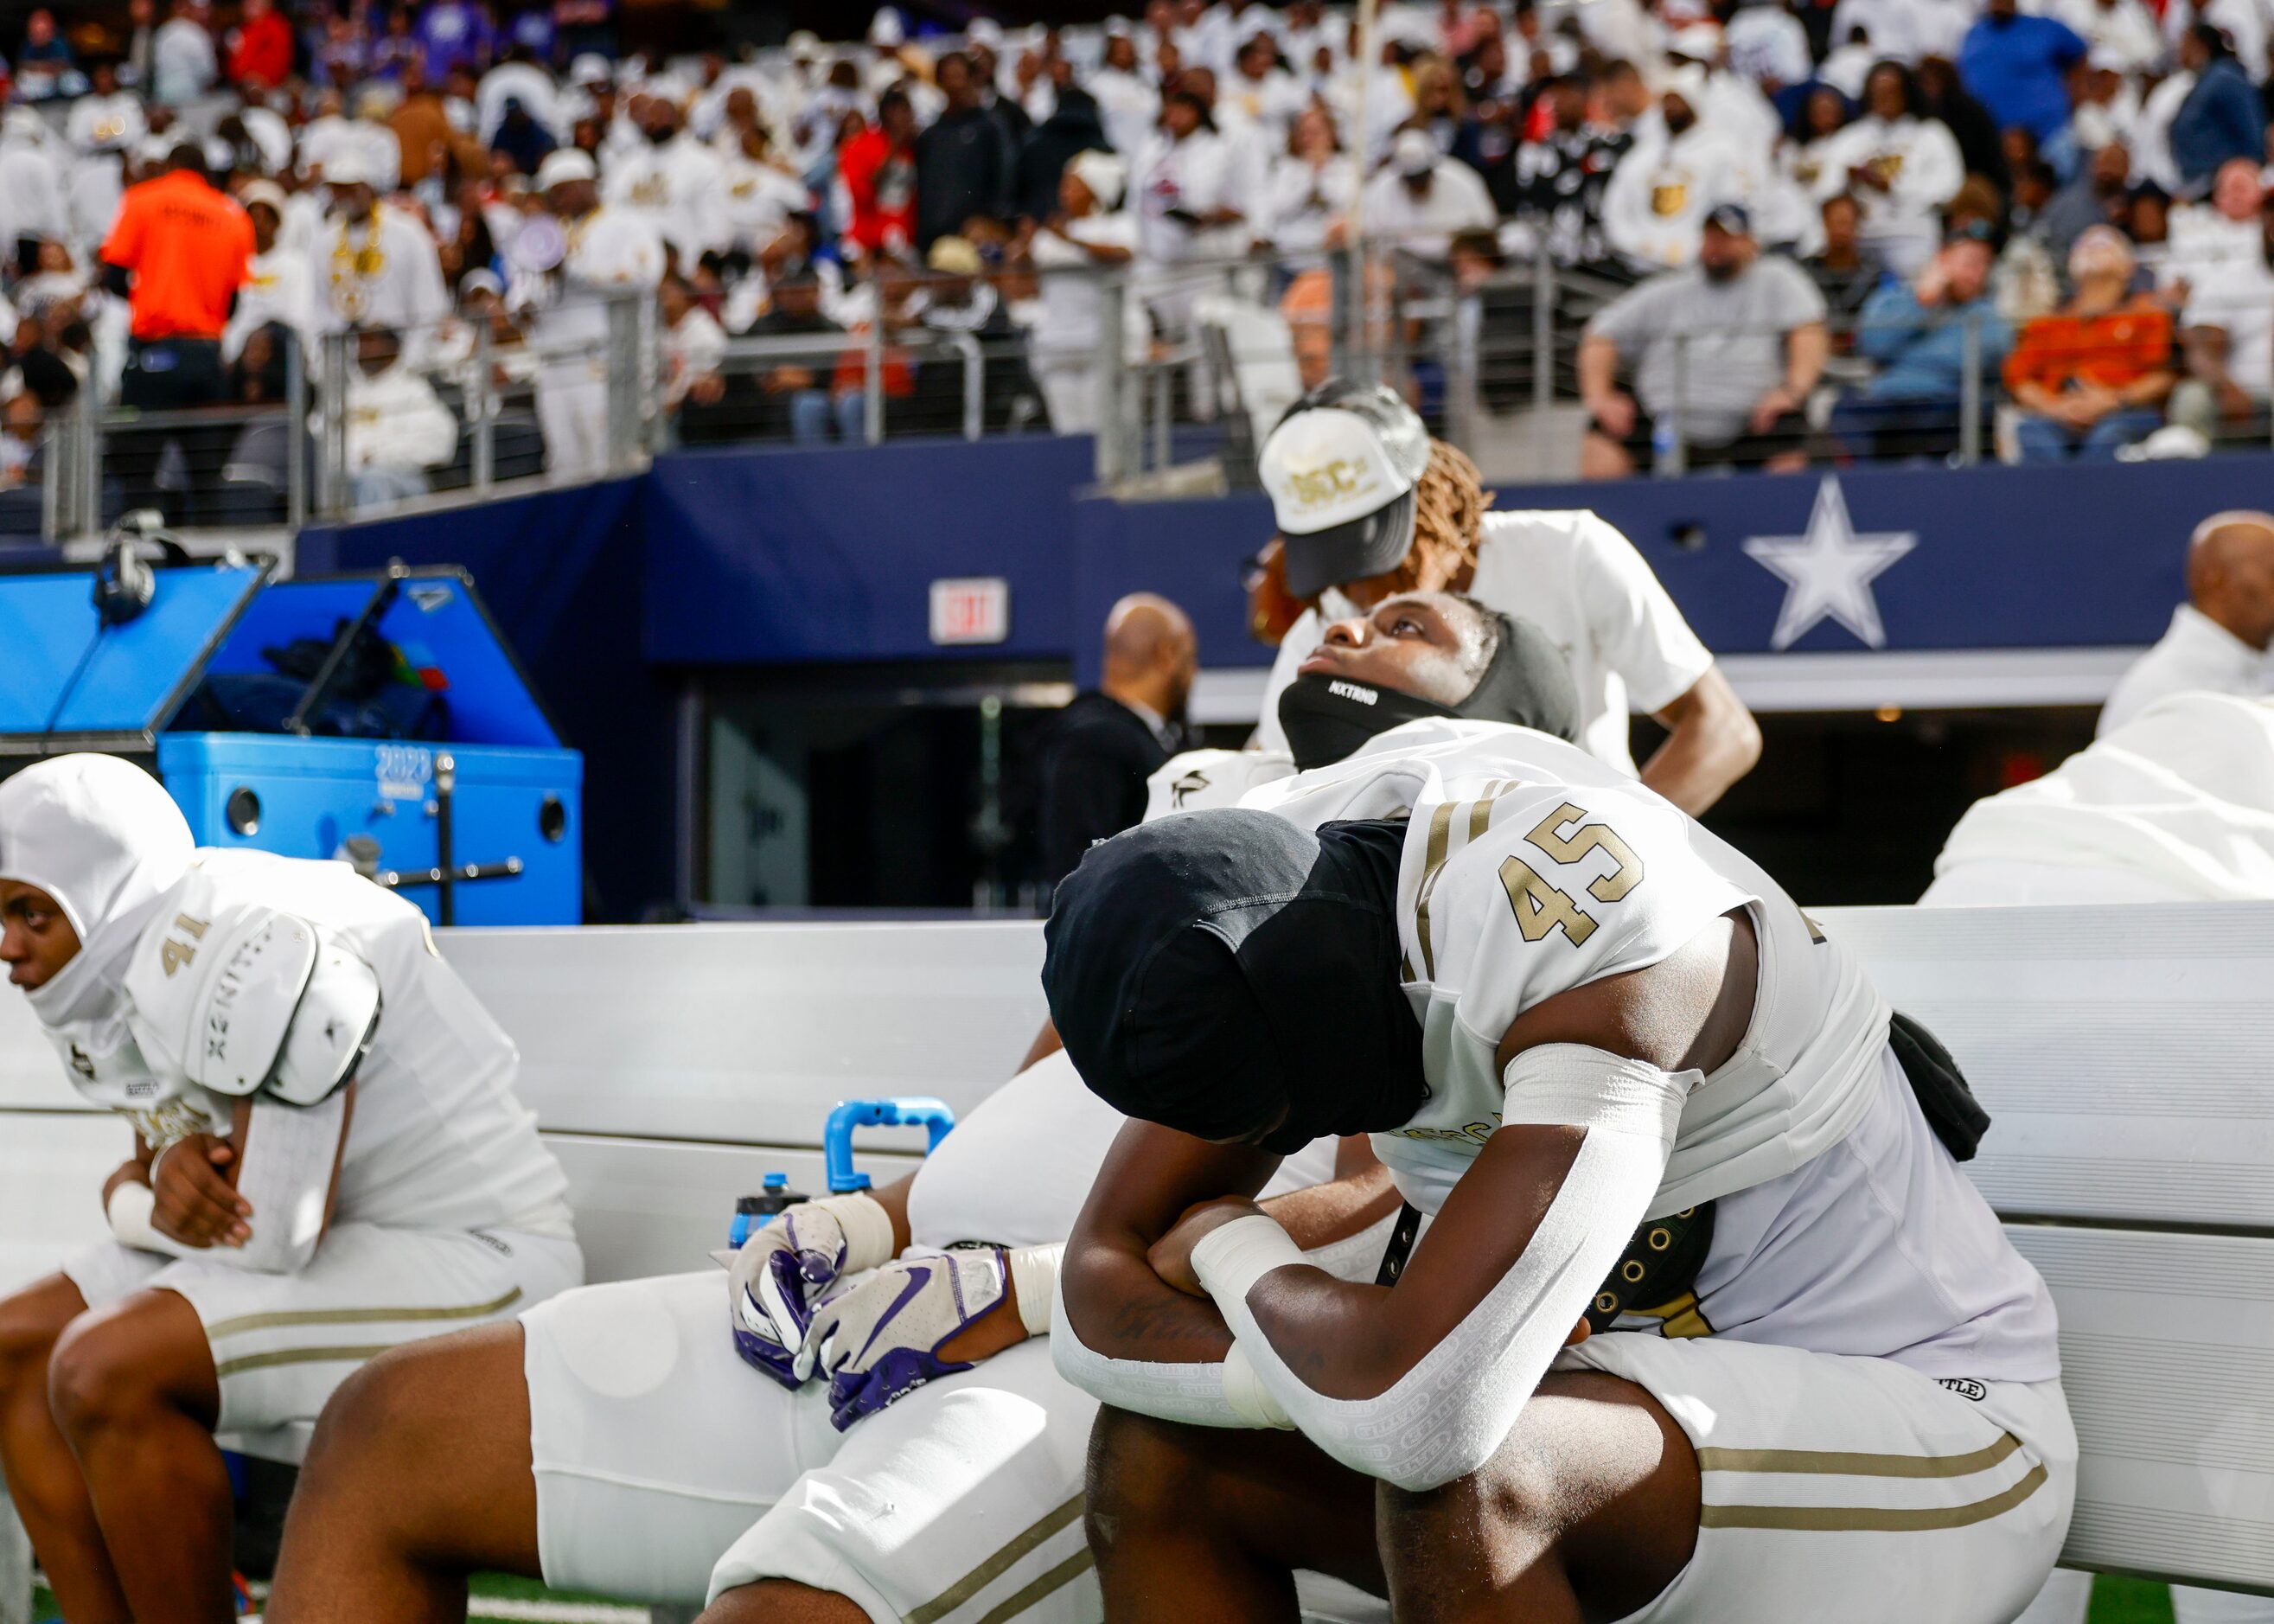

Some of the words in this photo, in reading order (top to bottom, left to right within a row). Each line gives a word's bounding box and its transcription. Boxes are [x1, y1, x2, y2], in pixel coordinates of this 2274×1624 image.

[1328, 680, 1378, 707] NXTRND
[375, 745, 432, 783] 2023
[1498, 802, 1644, 948] 45
[162, 912, 211, 977] 41
